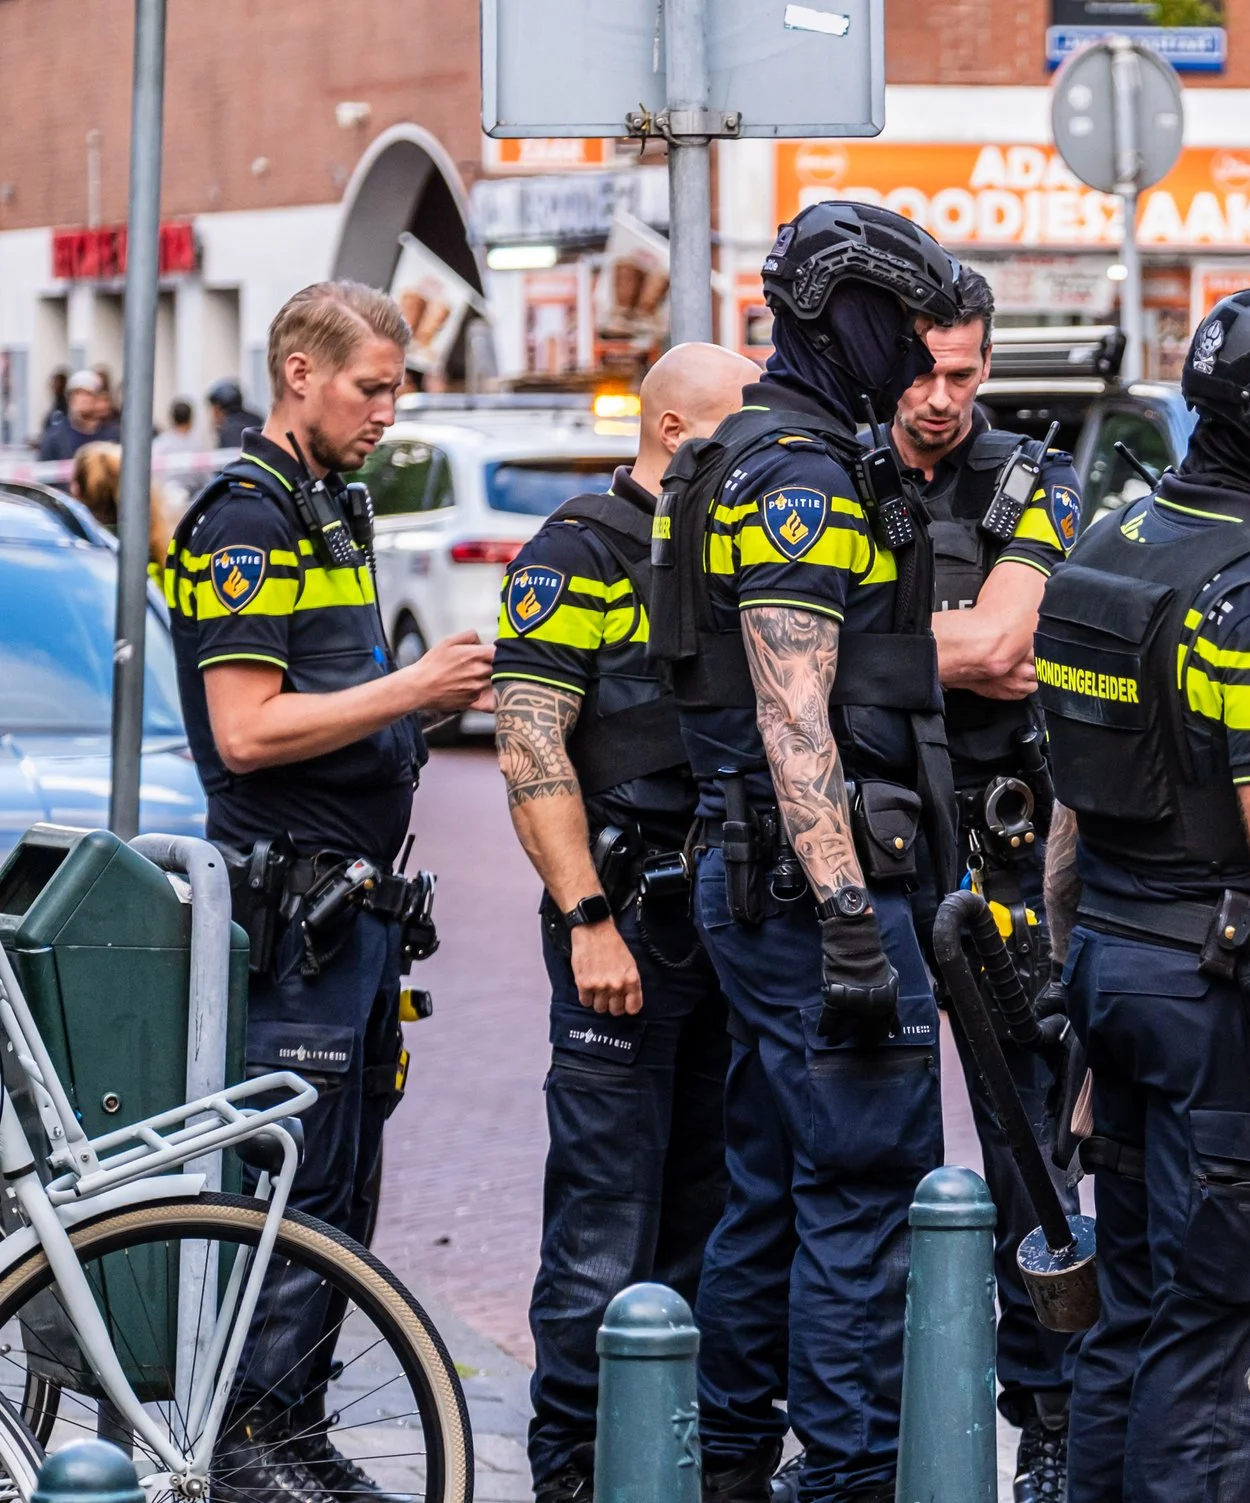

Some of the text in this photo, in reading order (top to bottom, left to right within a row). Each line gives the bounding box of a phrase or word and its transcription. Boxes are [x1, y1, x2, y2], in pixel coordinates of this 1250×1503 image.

[769, 498, 821, 511] POLITIE
[215, 555, 261, 569] POLITIE
[514, 575, 558, 588] POLITIE
[1035, 656, 1140, 704] HONDENGELEIDER
